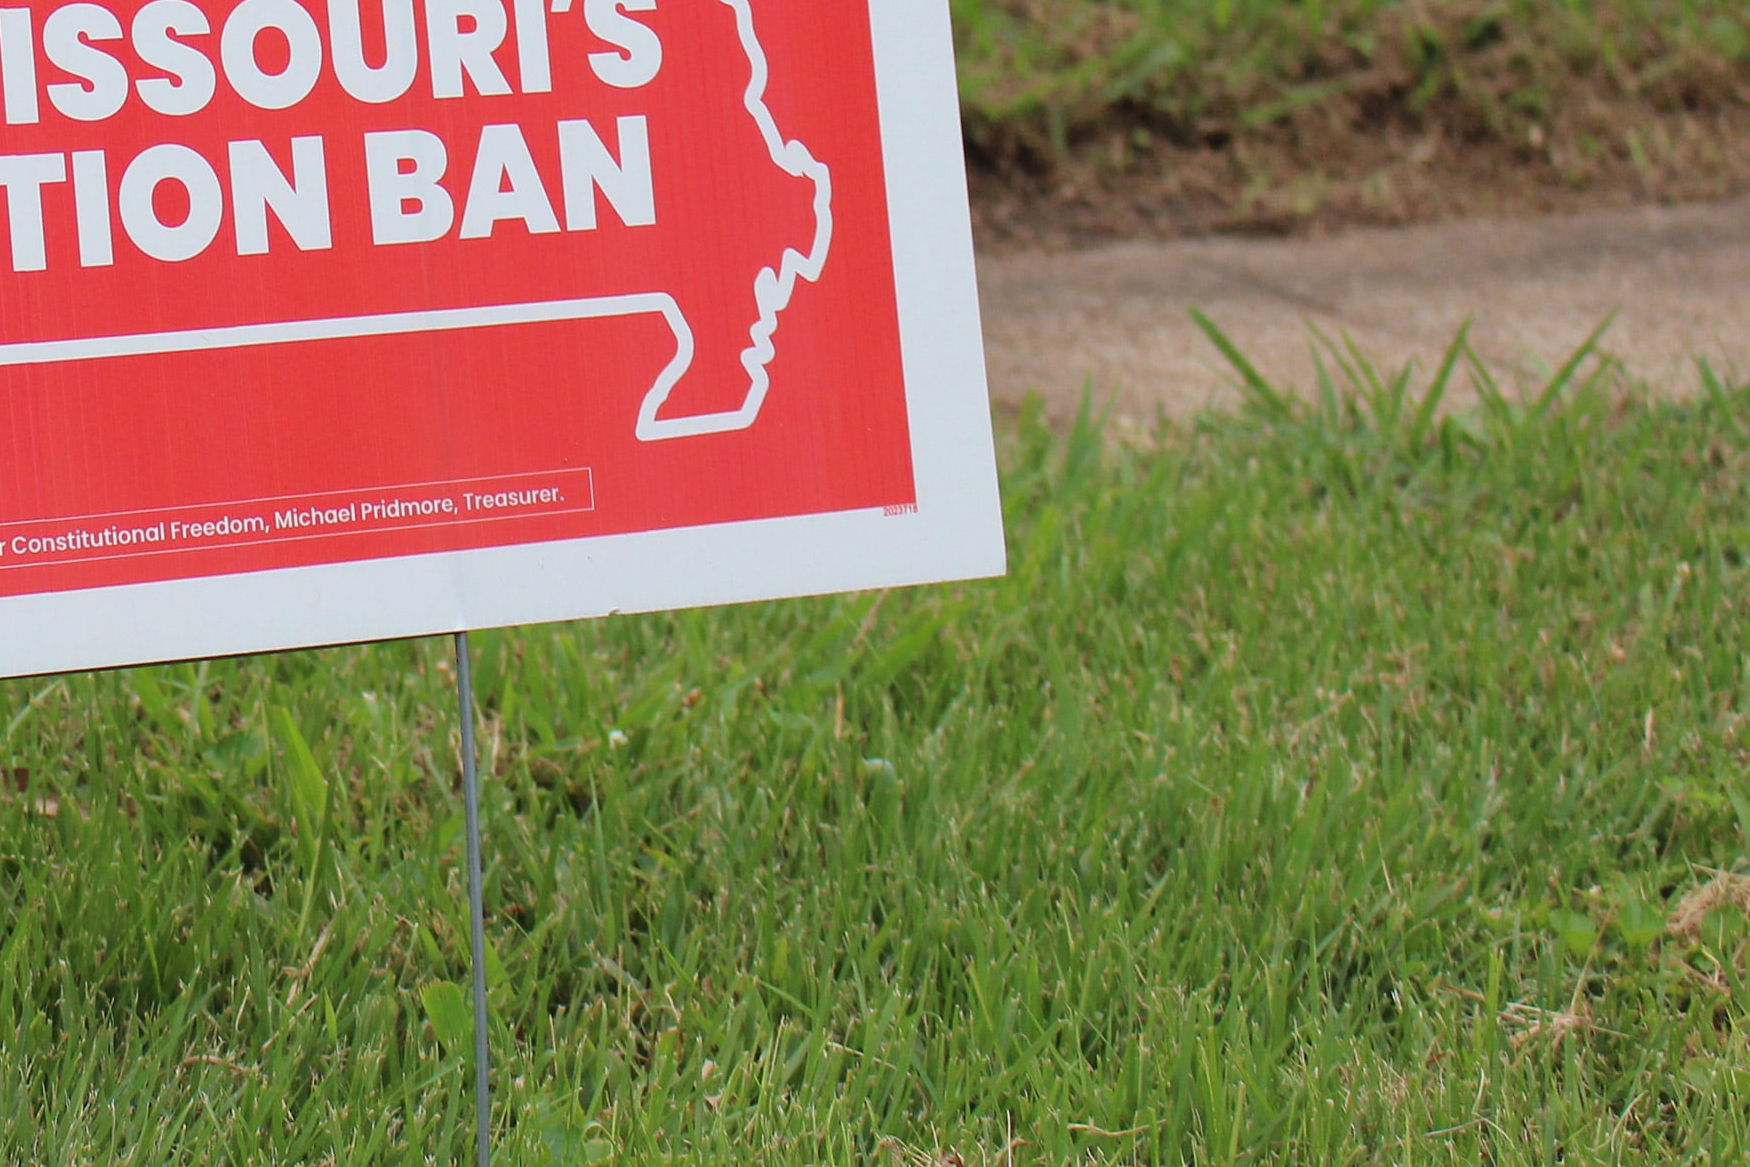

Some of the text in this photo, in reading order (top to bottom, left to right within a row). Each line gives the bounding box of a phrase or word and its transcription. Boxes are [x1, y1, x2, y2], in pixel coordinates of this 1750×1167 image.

[364, 115, 655, 245] BAN
[11, 521, 165, 555] Constitutional
[170, 516, 270, 540] Freedom,
[274, 503, 356, 529] Michael
[360, 498, 459, 521] Pridmore,
[462, 487, 566, 511] Treasurer.
